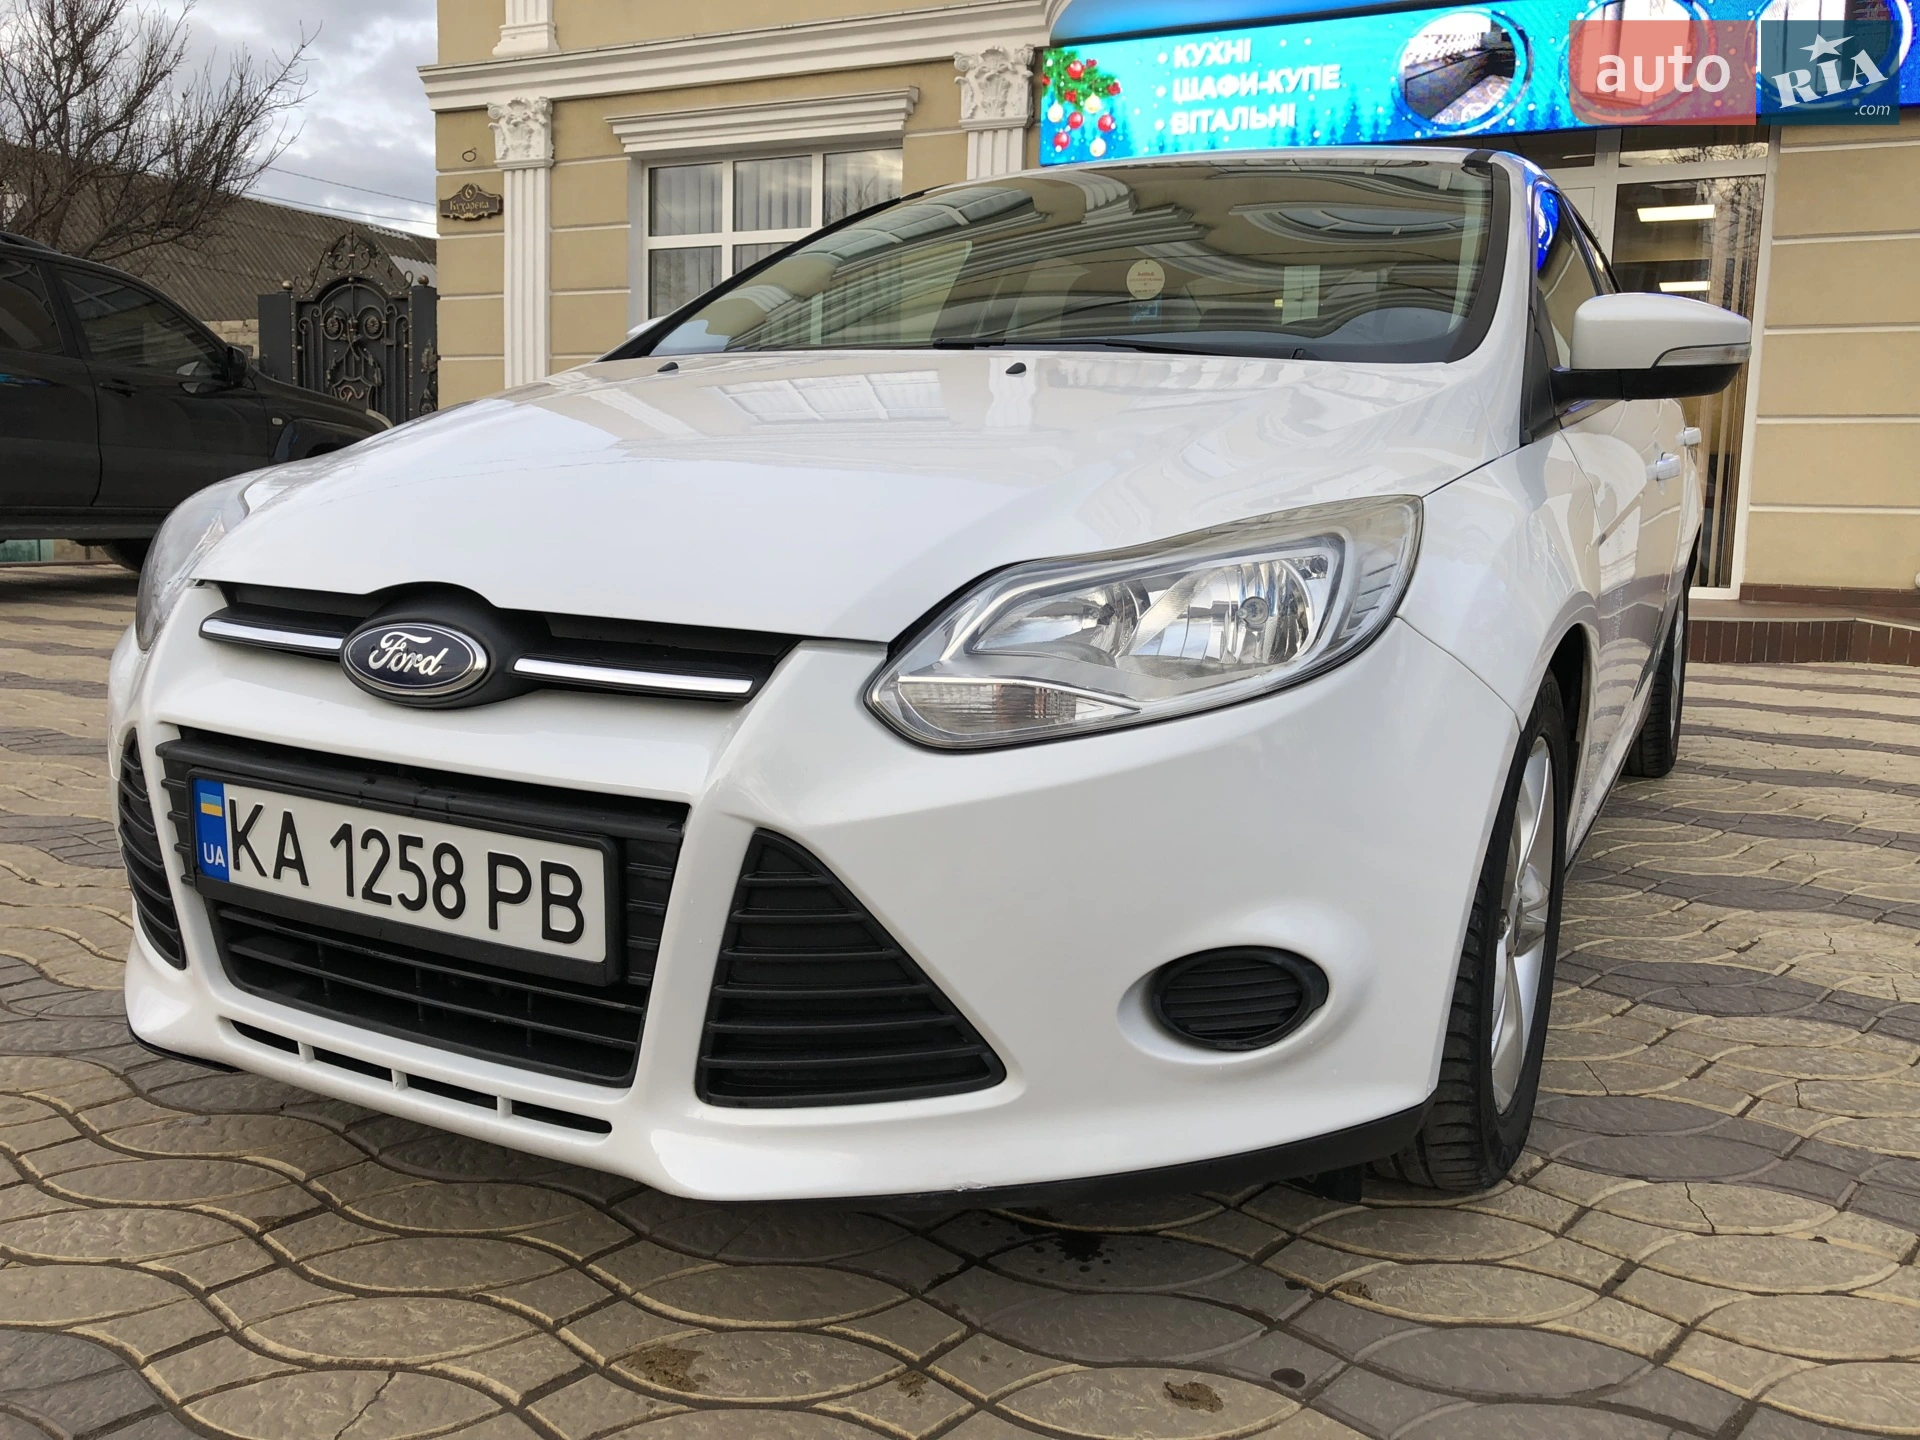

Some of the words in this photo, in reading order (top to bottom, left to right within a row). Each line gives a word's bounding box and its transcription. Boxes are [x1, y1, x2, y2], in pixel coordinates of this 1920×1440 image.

[1173, 37, 1252, 69] КУХНІ
[1172, 64, 1342, 102] ШАФИ-КУПЕ
[1170, 102, 1297, 135] ВІТАЛЬНІ
[368, 631, 450, 676] Ford
[203, 842, 226, 868] UA
[229, 798, 310, 887] KA
[329, 823, 467, 920] 1258
[487, 851, 585, 945] PB
